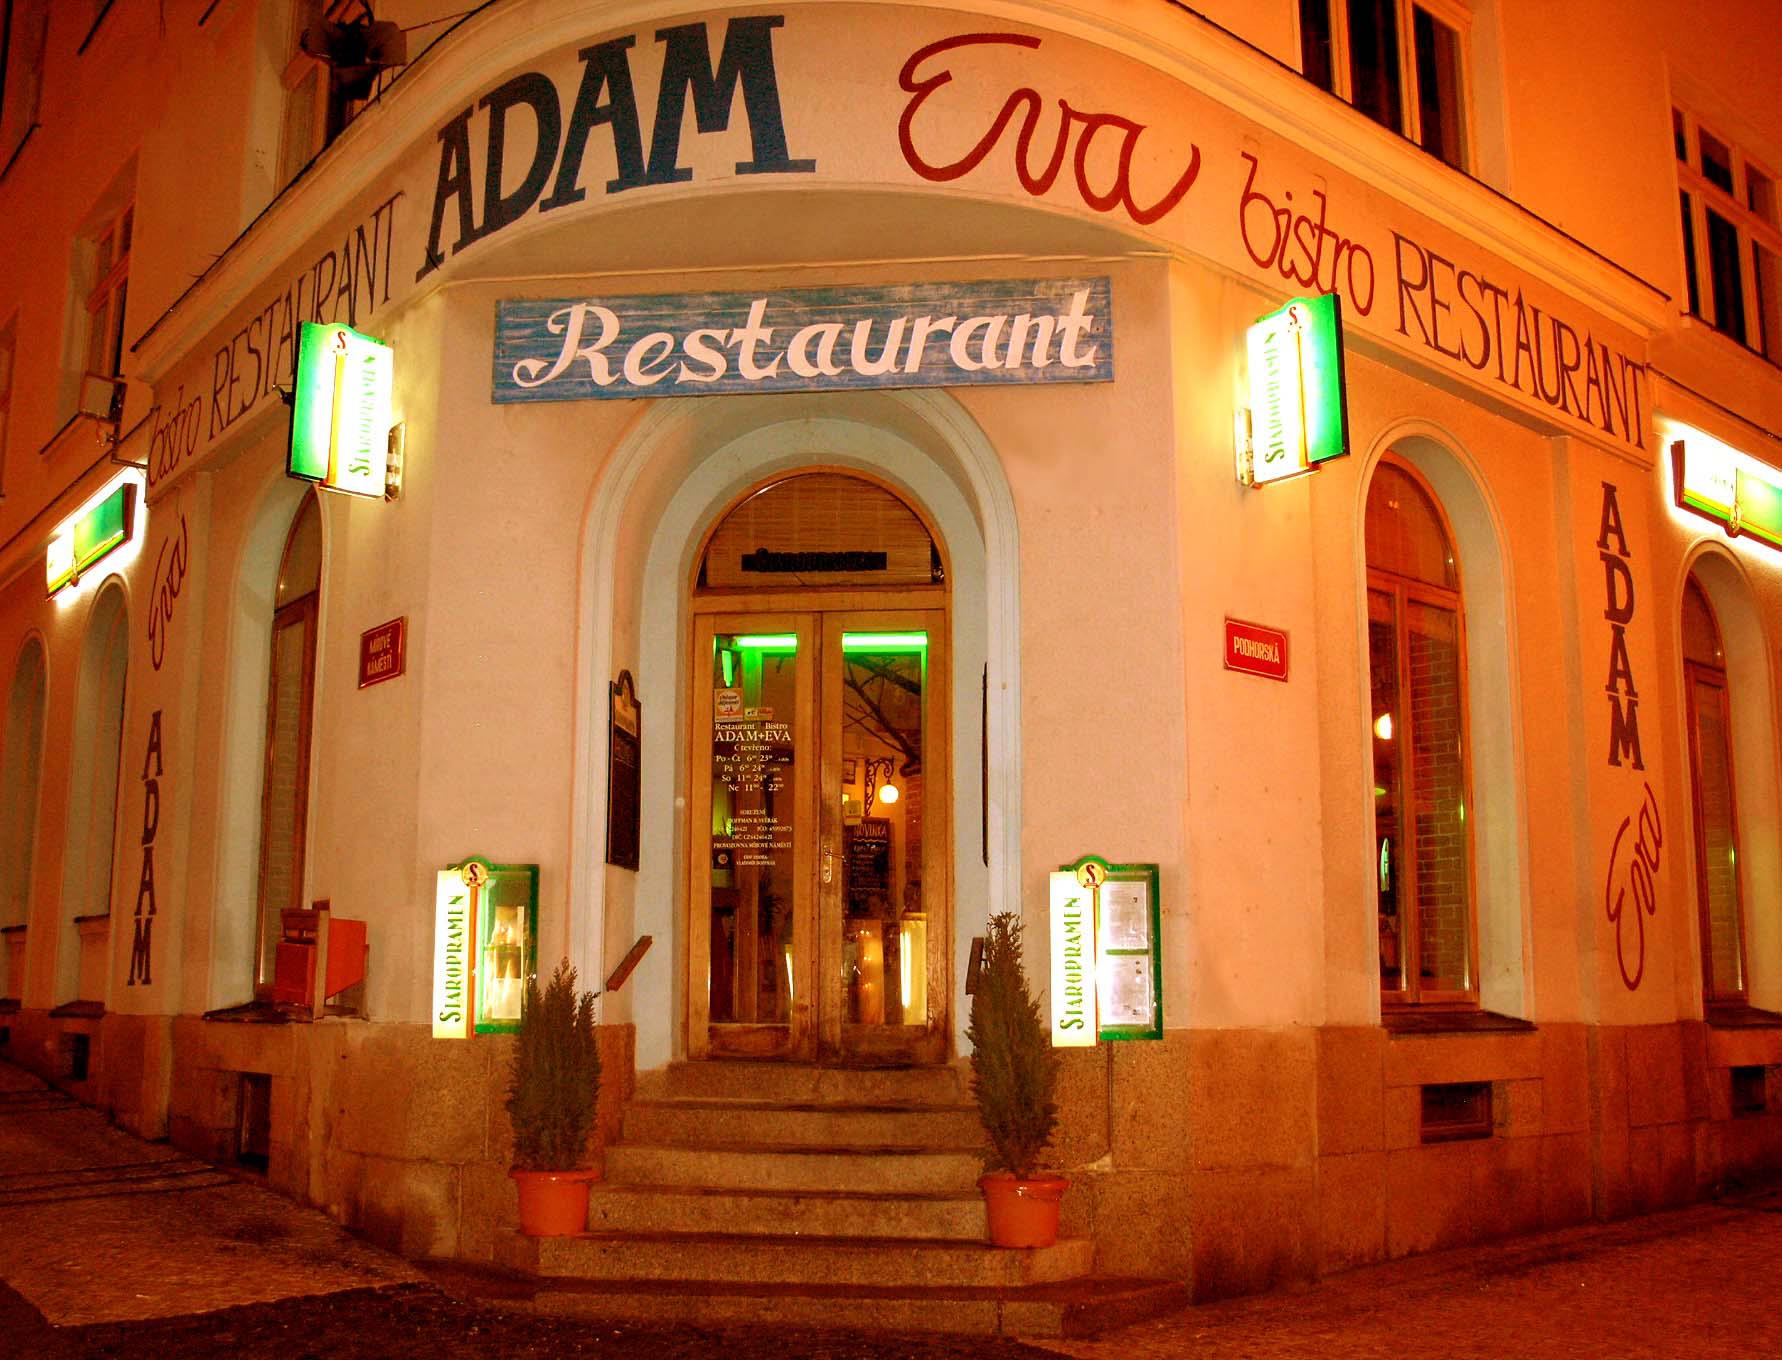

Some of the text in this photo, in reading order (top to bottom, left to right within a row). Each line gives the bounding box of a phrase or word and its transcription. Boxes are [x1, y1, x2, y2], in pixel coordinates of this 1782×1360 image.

[415, 15, 816, 283] ADAM
[898, 33, 1200, 225] Eva
[513, 289, 1098, 389] Restaurant
[1240, 151, 1649, 450] bistro RESTAURANT
[149, 384, 202, 487] bistro
[1233, 636, 1280, 664] PODHORSKÁ
[1596, 480, 1645, 771] ADAM
[765, 722, 788, 730] Bistro
[127, 710, 163, 986] ADAM
[1606, 782, 1663, 991] Eva
[439, 895, 464, 1023] STAROPRAMEN
